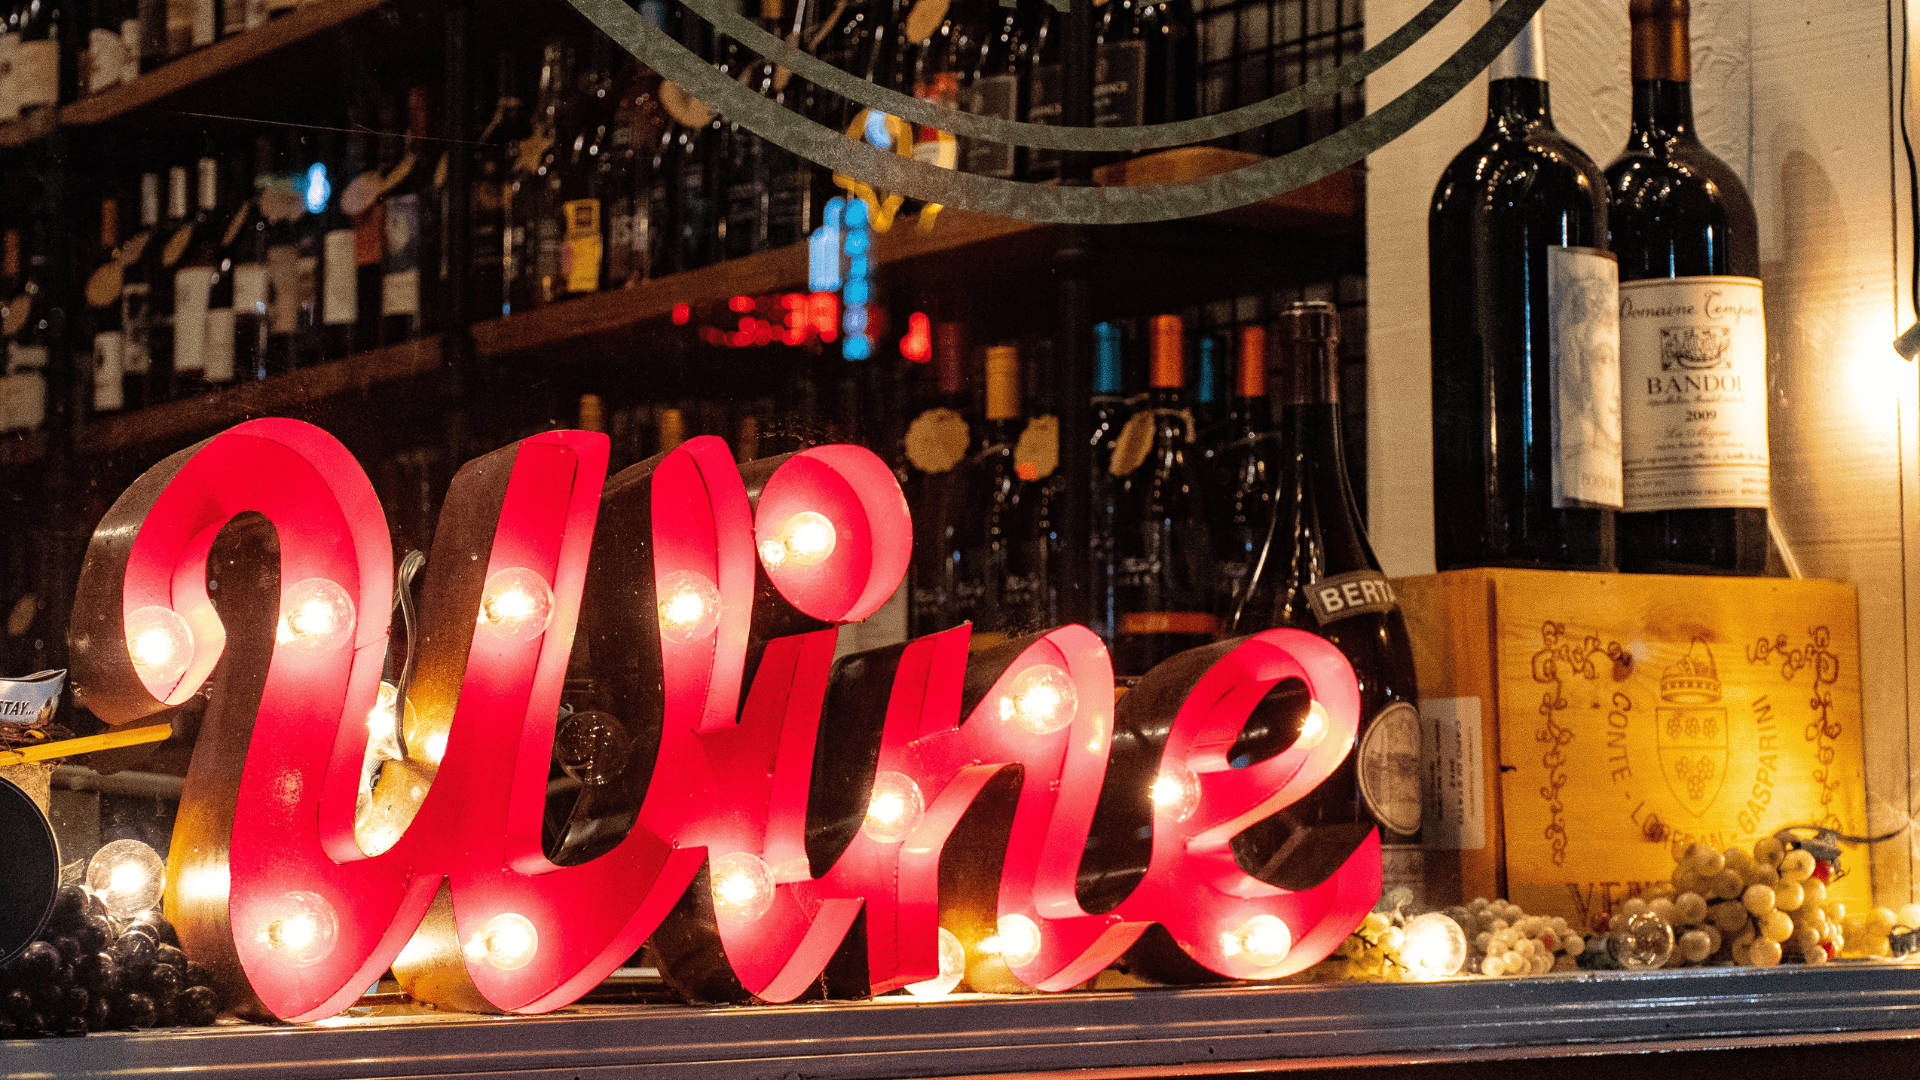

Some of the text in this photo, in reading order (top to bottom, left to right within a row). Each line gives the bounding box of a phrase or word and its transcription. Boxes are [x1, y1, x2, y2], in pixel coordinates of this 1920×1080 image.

[1619, 297, 1694, 320] Domaine
[1685, 409, 1717, 423] 2009
[72, 417, 1383, 1022] Wine
[1607, 691, 1632, 784] CONTE
[1737, 695, 1779, 836] GASPARINI
